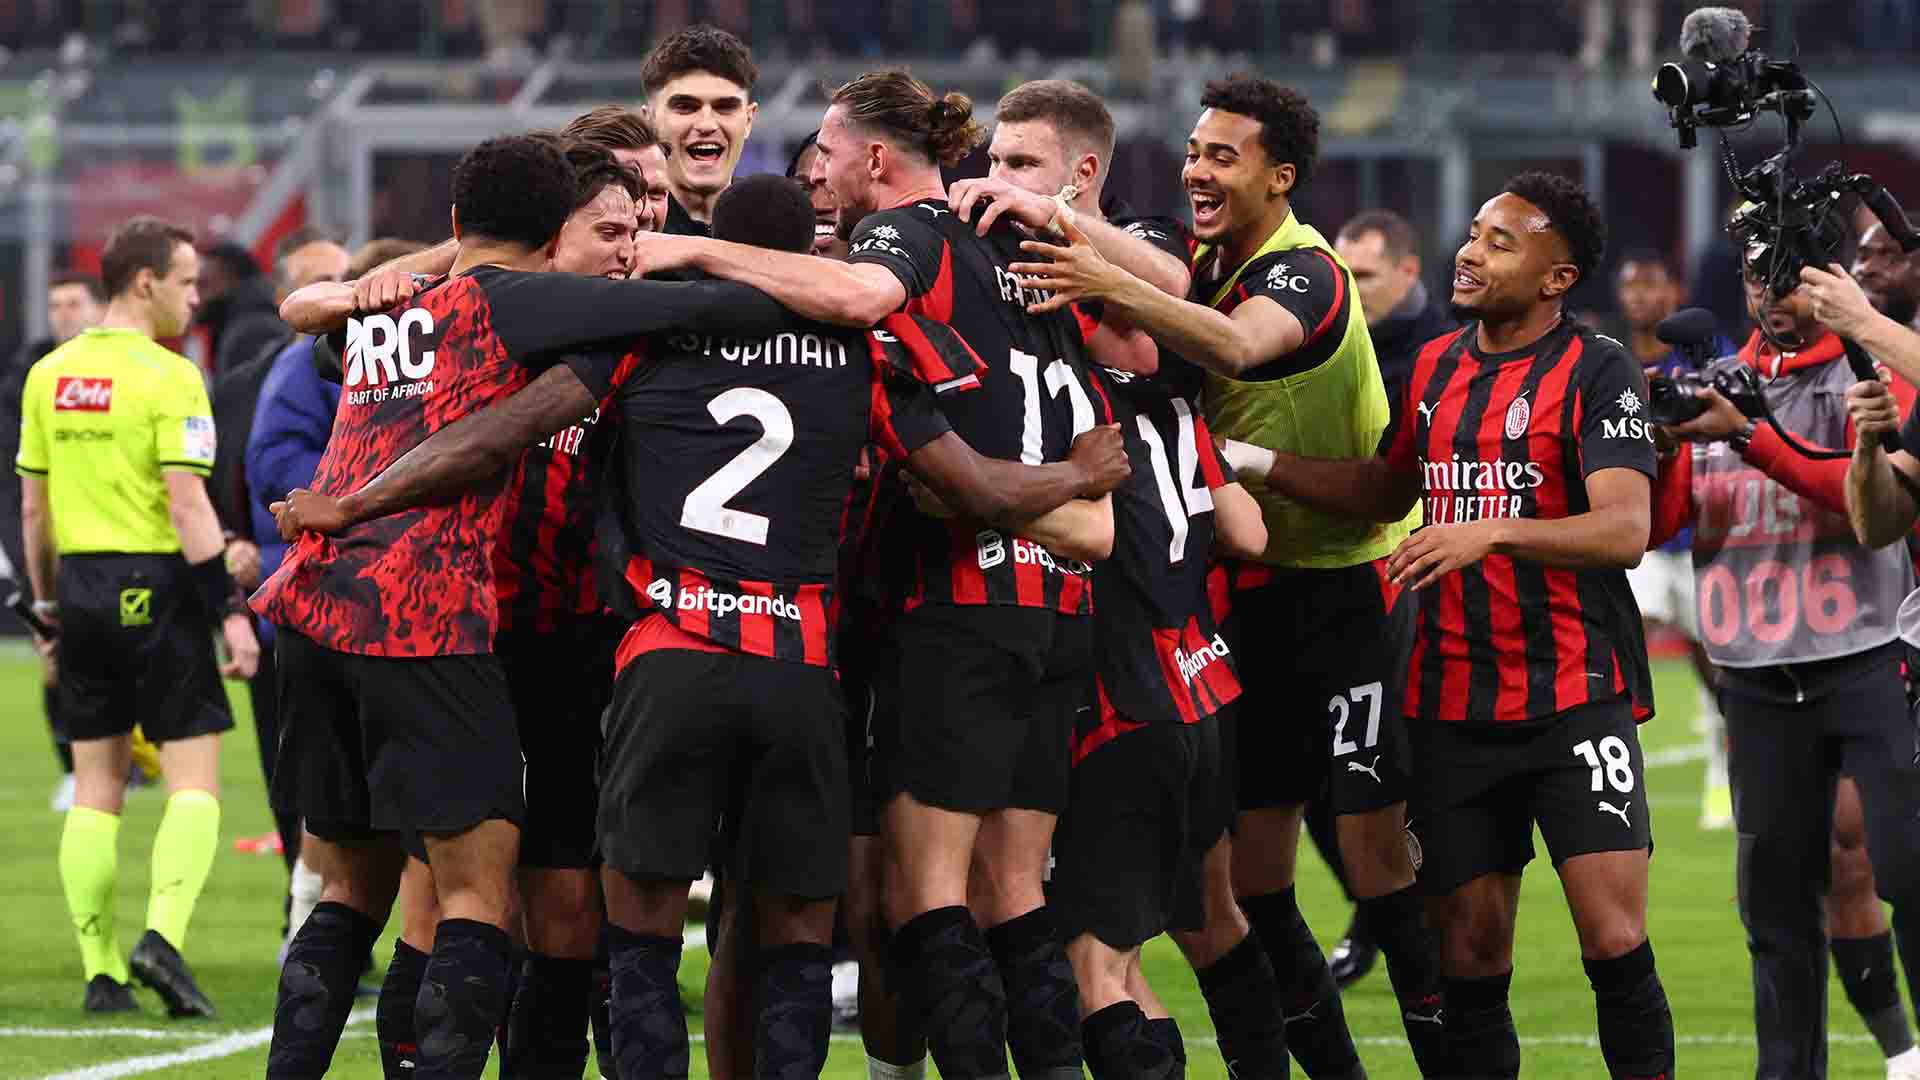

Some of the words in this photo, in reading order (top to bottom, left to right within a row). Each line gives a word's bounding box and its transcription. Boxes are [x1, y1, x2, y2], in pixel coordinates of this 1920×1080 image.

[1268, 275, 1309, 293] SC
[347, 390, 372, 404] EART
[373, 388, 389, 402] OF
[391, 380, 434, 399] AFRICA
[680, 387, 795, 546] 2
[1418, 453, 1544, 490] mirates
[1454, 495, 1522, 523] BETTER
[678, 586, 802, 620] bitpanda
[1701, 554, 1857, 646] 006
[1328, 681, 1383, 757] 27
[1573, 736, 1635, 793] 18
